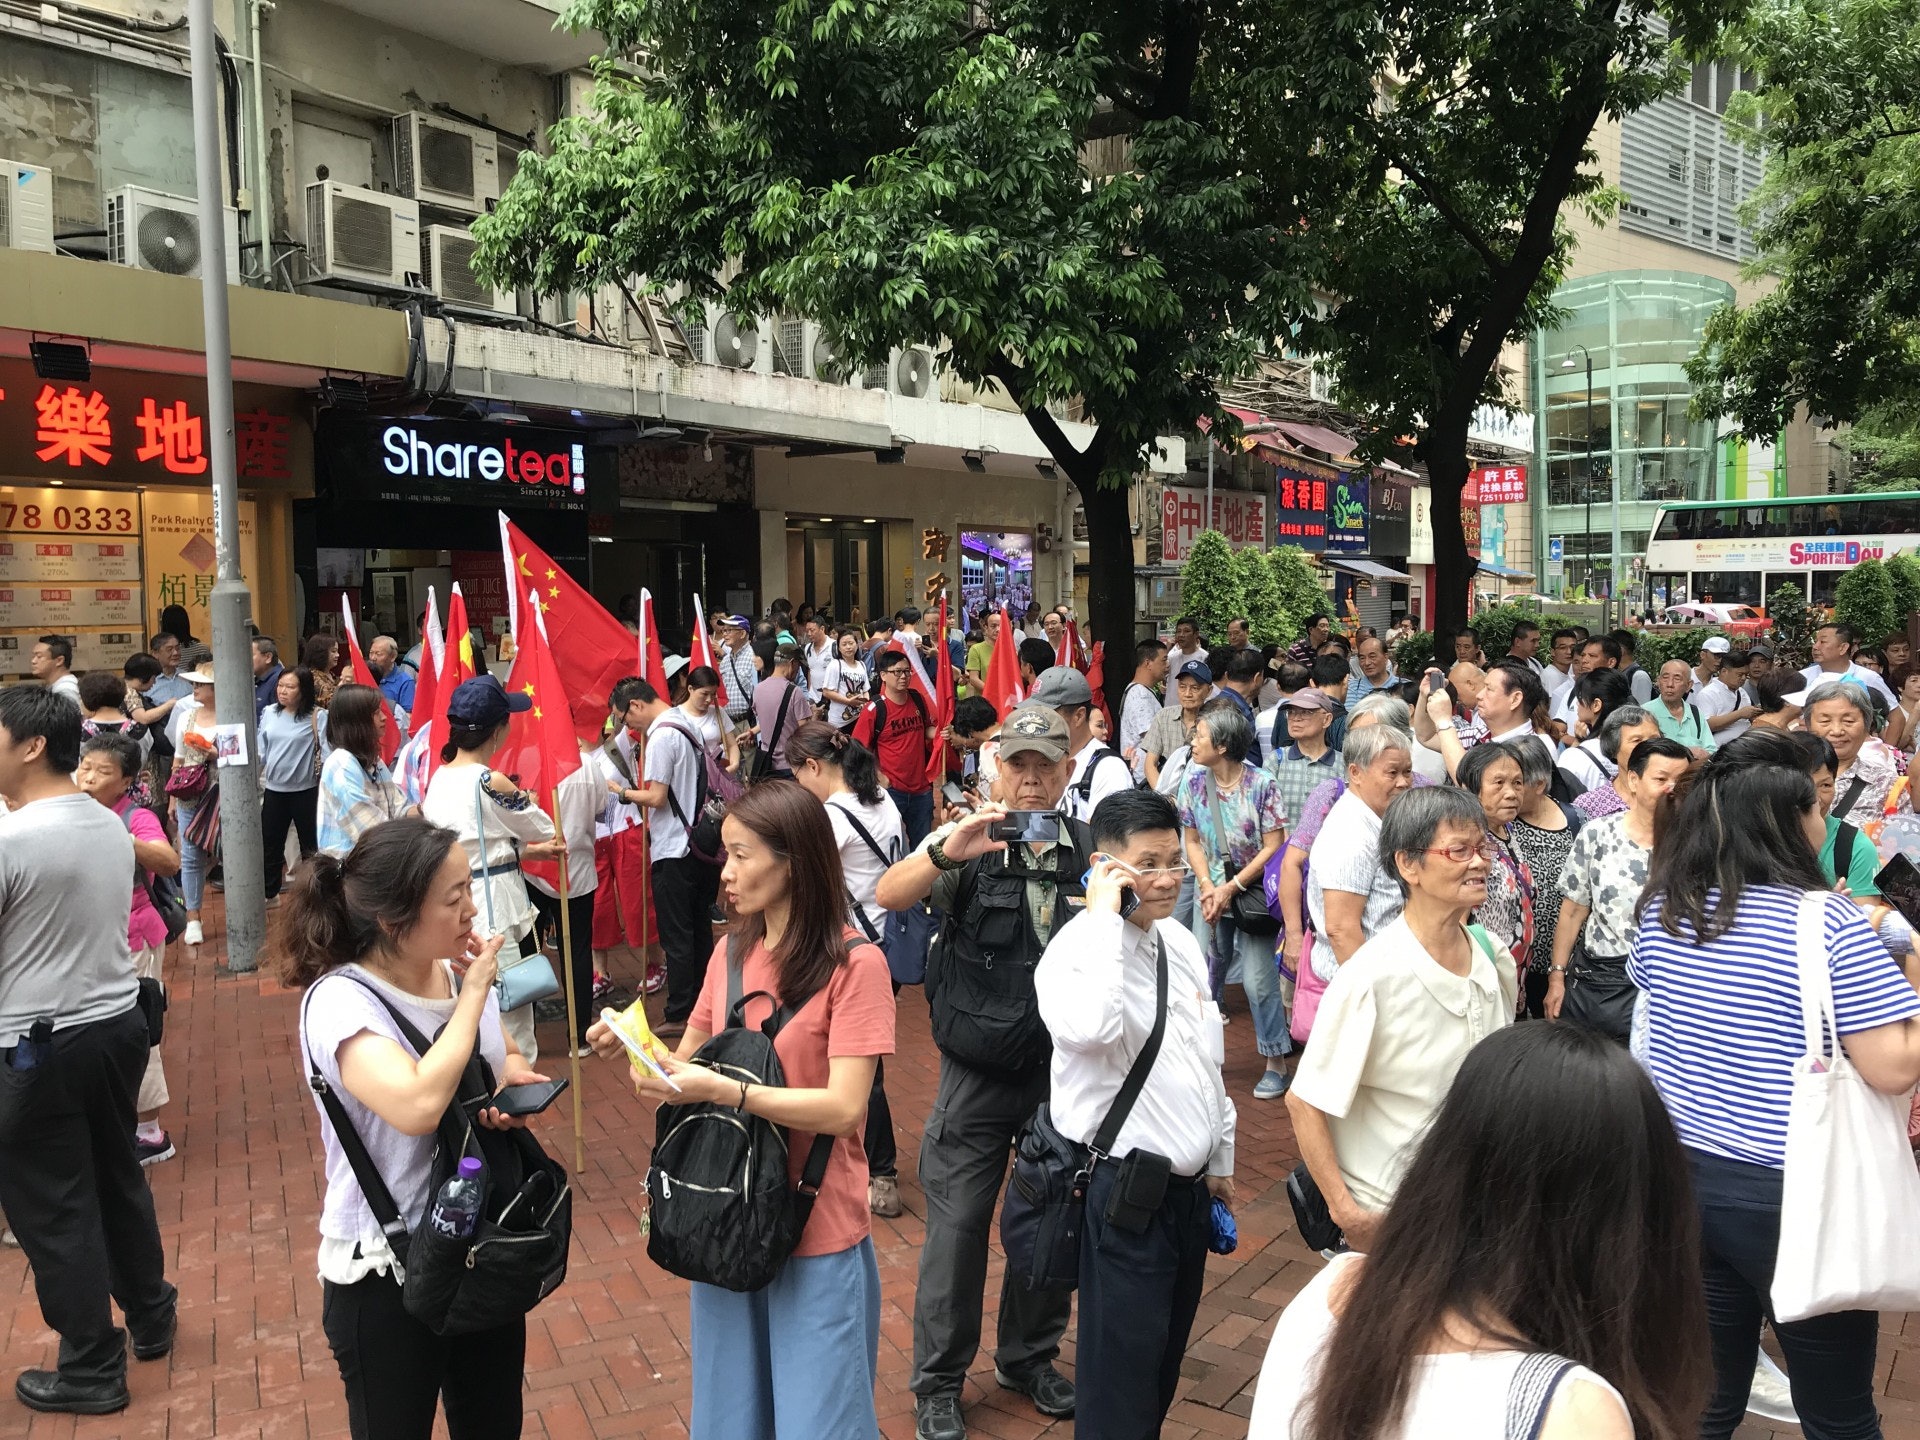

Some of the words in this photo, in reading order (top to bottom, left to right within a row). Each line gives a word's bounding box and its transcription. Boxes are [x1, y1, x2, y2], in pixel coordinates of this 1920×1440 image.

[383, 426, 570, 486] Sharetea
[520, 486, 543, 497] Since
[53, 506, 132, 532] 0333
[151, 514, 173, 525] Park
[175, 515, 205, 526] Realty
